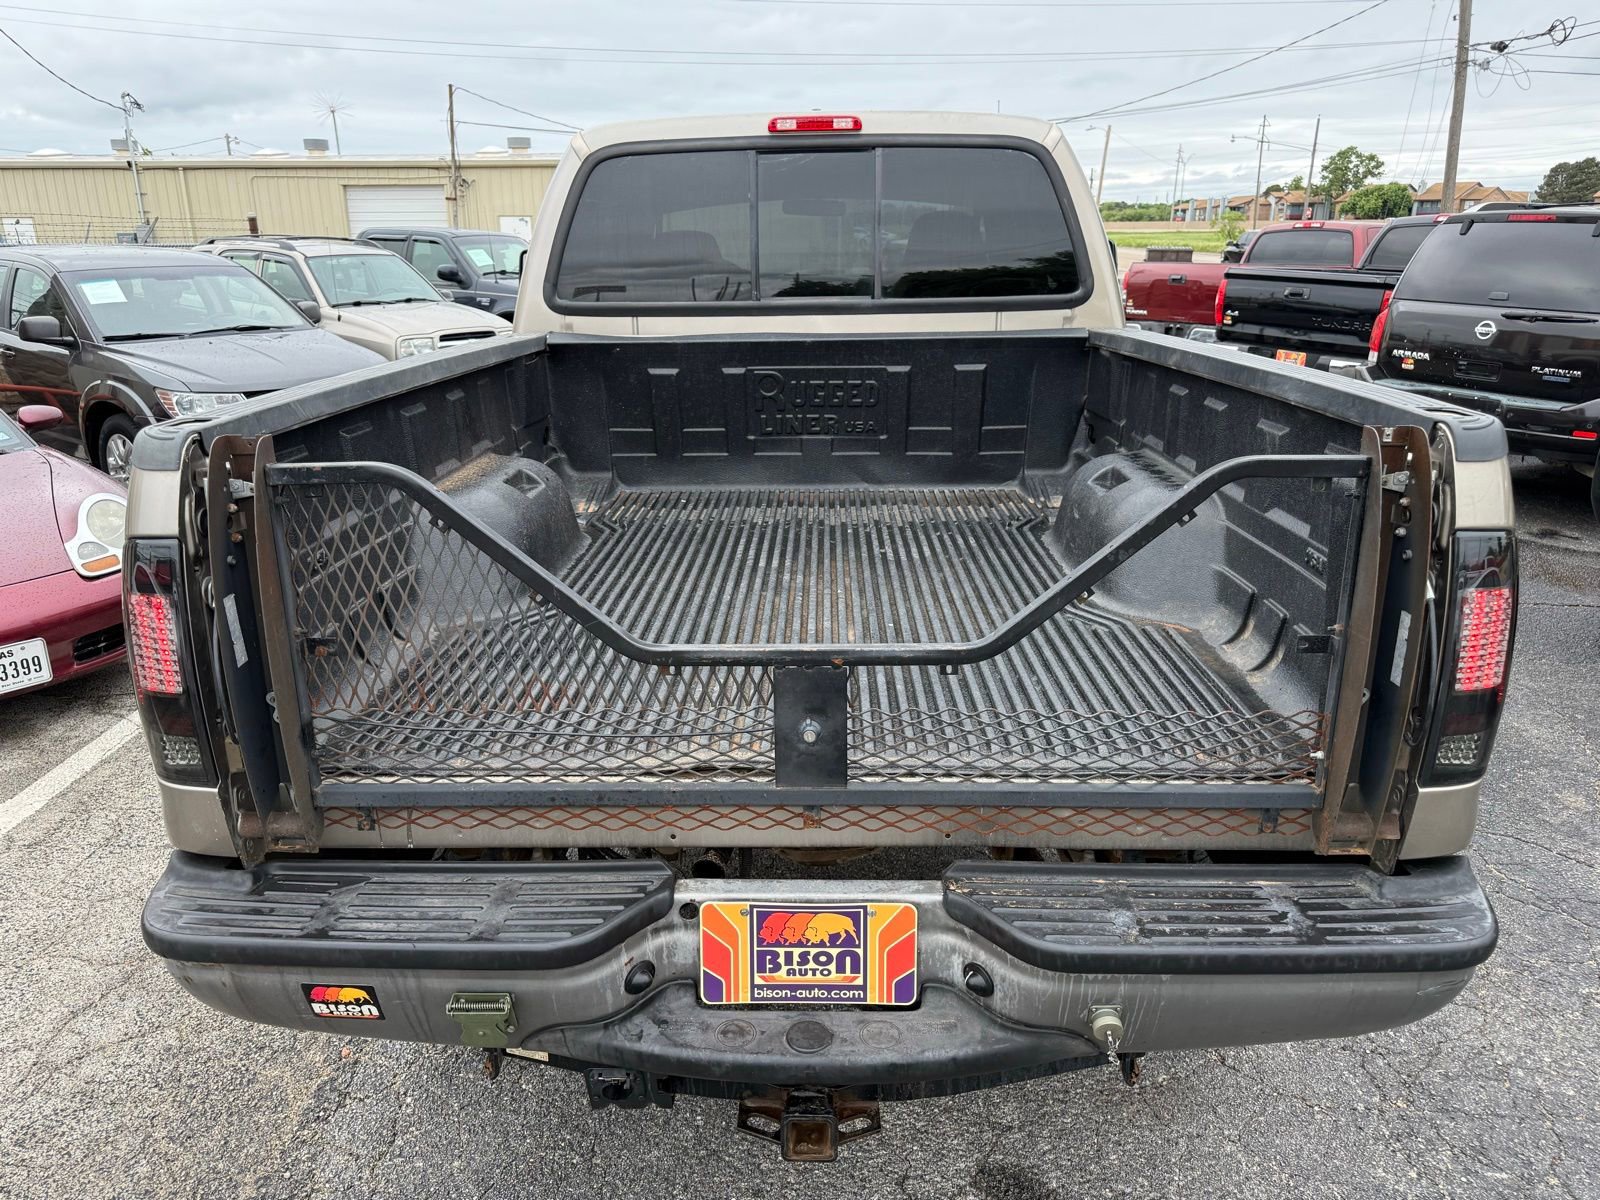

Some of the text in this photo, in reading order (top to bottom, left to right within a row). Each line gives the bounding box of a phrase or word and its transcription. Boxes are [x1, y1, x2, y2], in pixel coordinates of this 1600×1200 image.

[1312, 317, 1371, 331] TUNDRA
[1391, 349, 1430, 361] ARMADA
[1531, 366, 1582, 378] PLATINUM
[754, 370, 880, 412] RUGGED
[760, 414, 877, 435] LINER USA
[756, 949, 861, 975] BISON
[786, 967, 832, 977] AUTO
[754, 987, 864, 999] bison-auto.com
[311, 1003, 380, 1016] BISON
